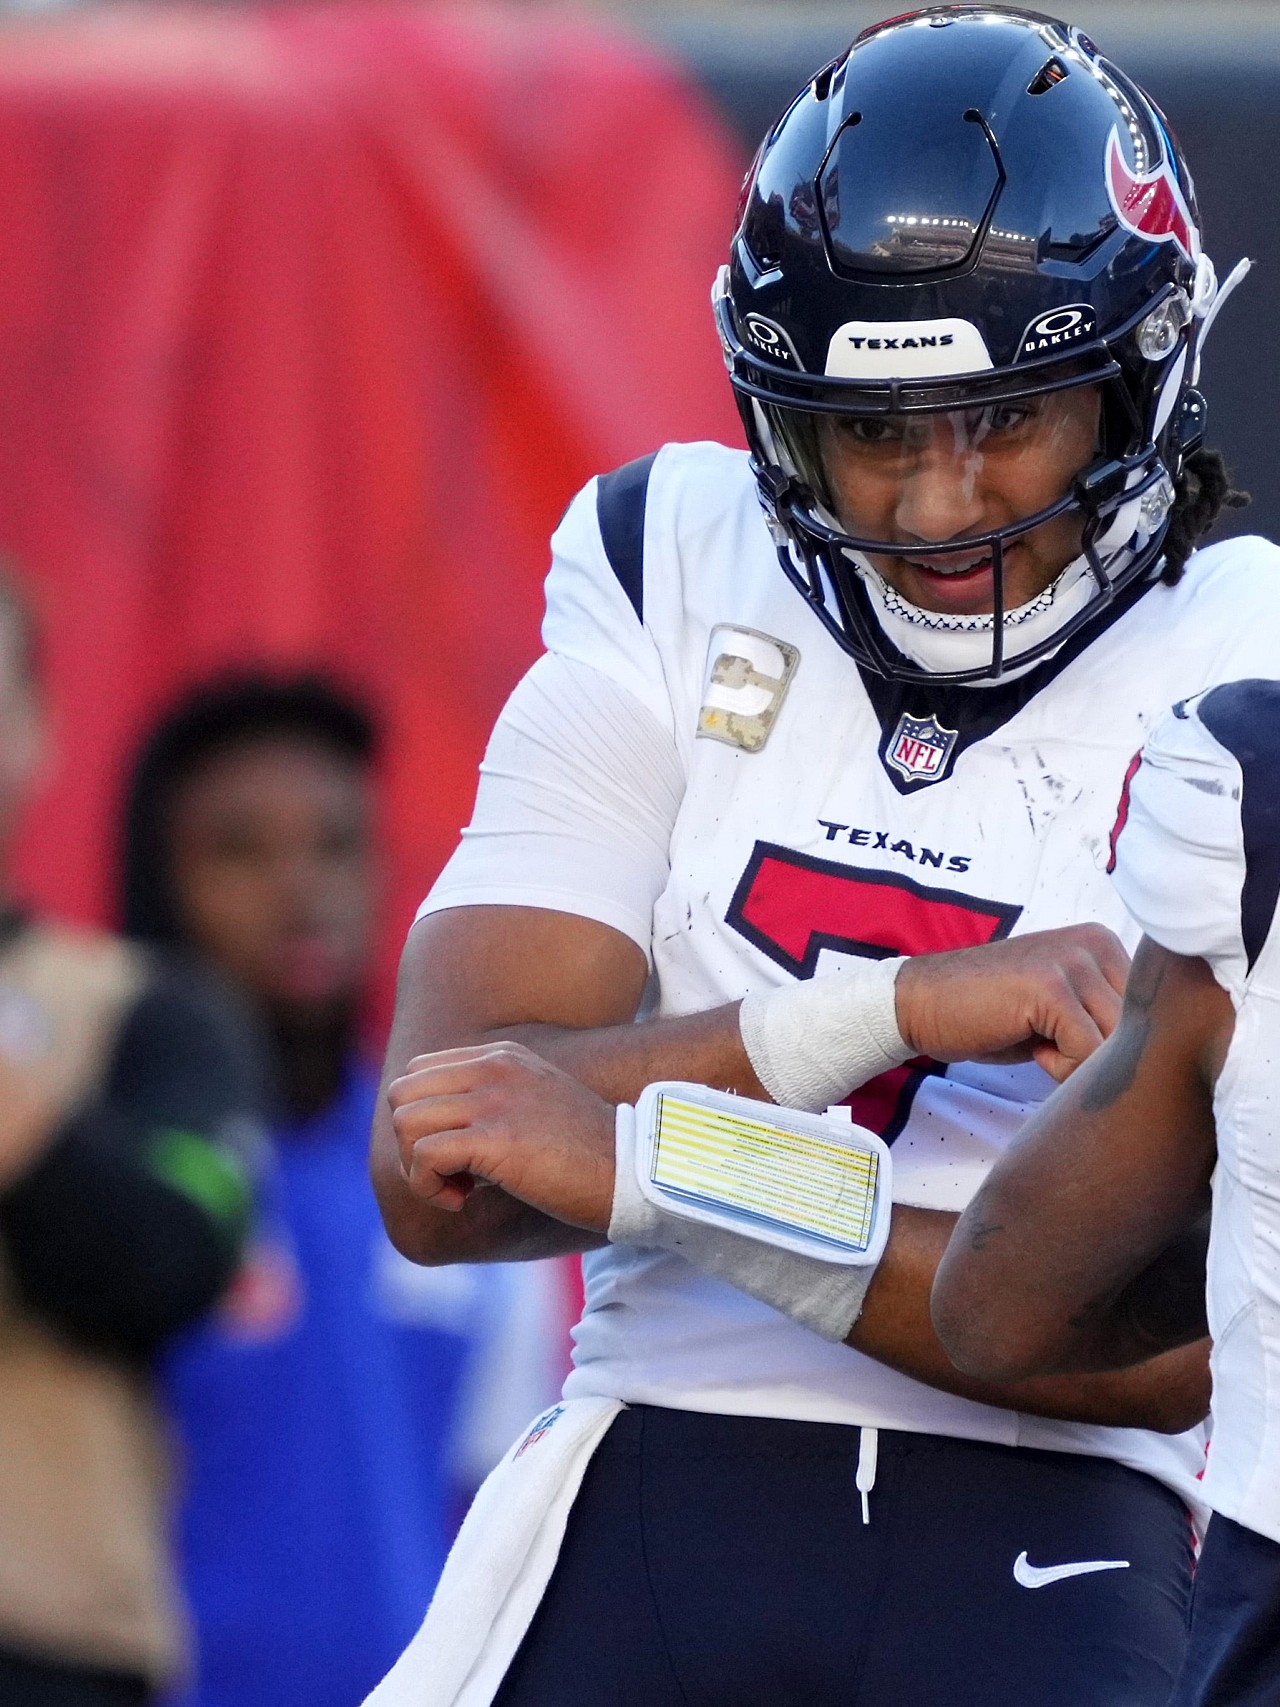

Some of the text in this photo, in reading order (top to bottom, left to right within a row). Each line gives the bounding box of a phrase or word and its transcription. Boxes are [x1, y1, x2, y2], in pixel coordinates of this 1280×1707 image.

[747, 333, 789, 360] OAKLEY
[848, 334, 955, 351] TEXANS
[1025, 322, 1092, 352] OAKLEY
[897, 736, 943, 772] NFL
[818, 819, 972, 873] TEXANS
